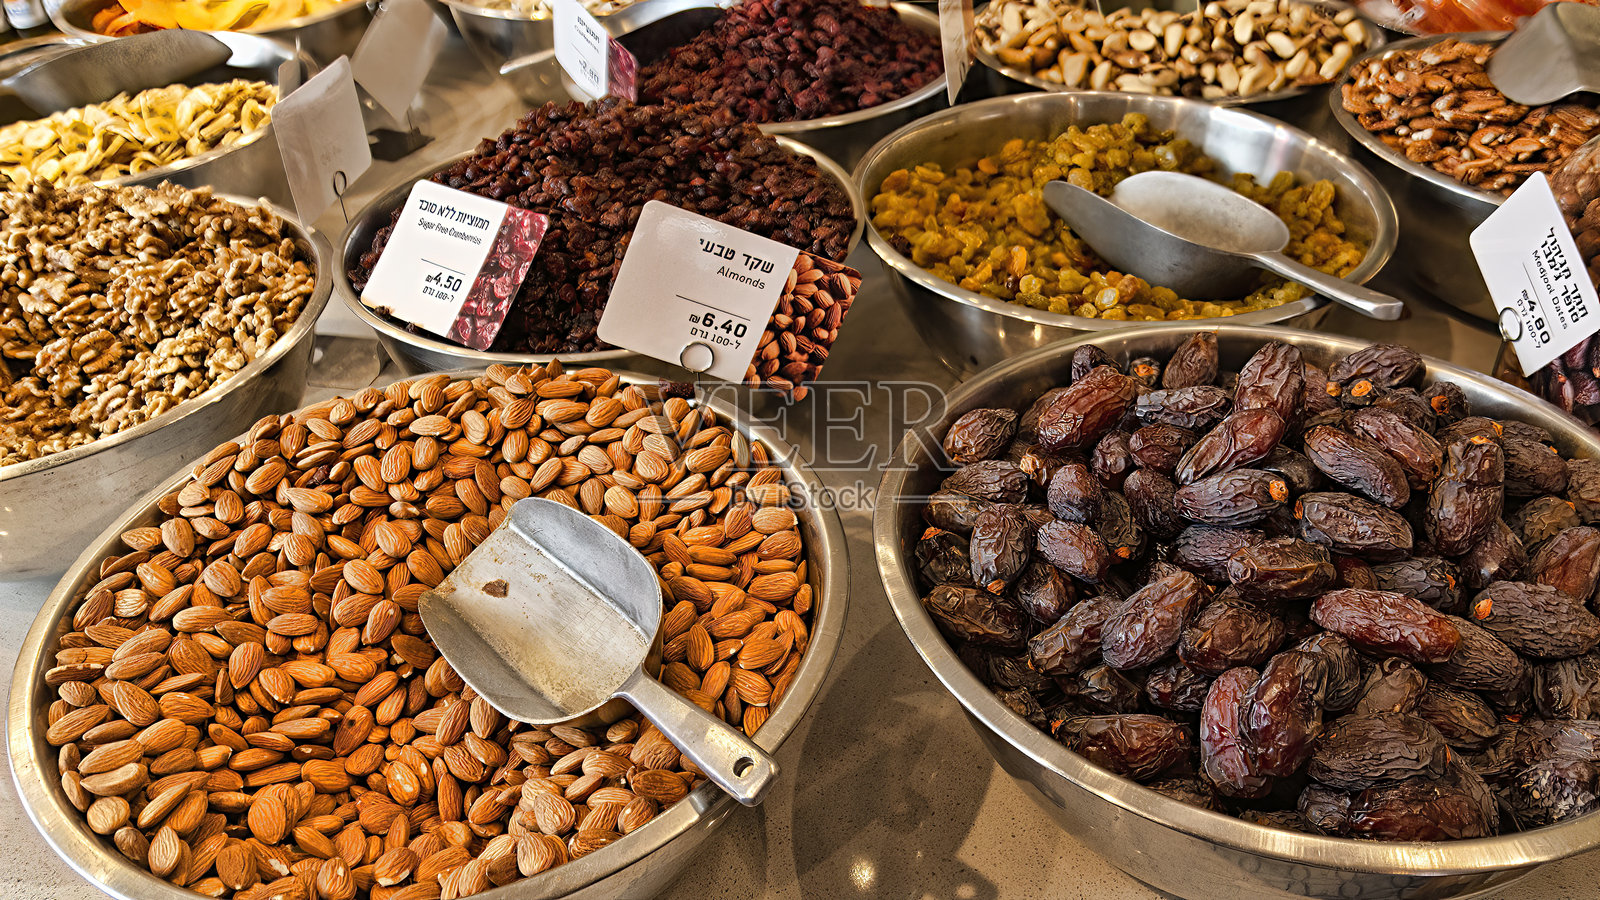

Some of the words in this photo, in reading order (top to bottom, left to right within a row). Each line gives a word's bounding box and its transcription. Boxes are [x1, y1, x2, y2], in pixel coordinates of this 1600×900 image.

[419, 199, 438, 214] סוכר
[437, 205, 456, 220] ללא
[418, 217, 436, 230] Sugar
[435, 222, 449, 235] Free
[455, 211, 490, 231] חמוציות
[699, 238, 736, 261] טבעי
[742, 253, 775, 274] שקד
[716, 265, 766, 290] Almonds
[422, 285, 436, 296] גרם
[1532, 249, 1555, 295] Medjool
[1552, 296, 1568, 330] Dates
[1517, 298, 1528, 318] גרם
[1561, 285, 1580, 323] סופר
[1570, 283, 1589, 318] תמר
[690, 327, 709, 340] גרם
